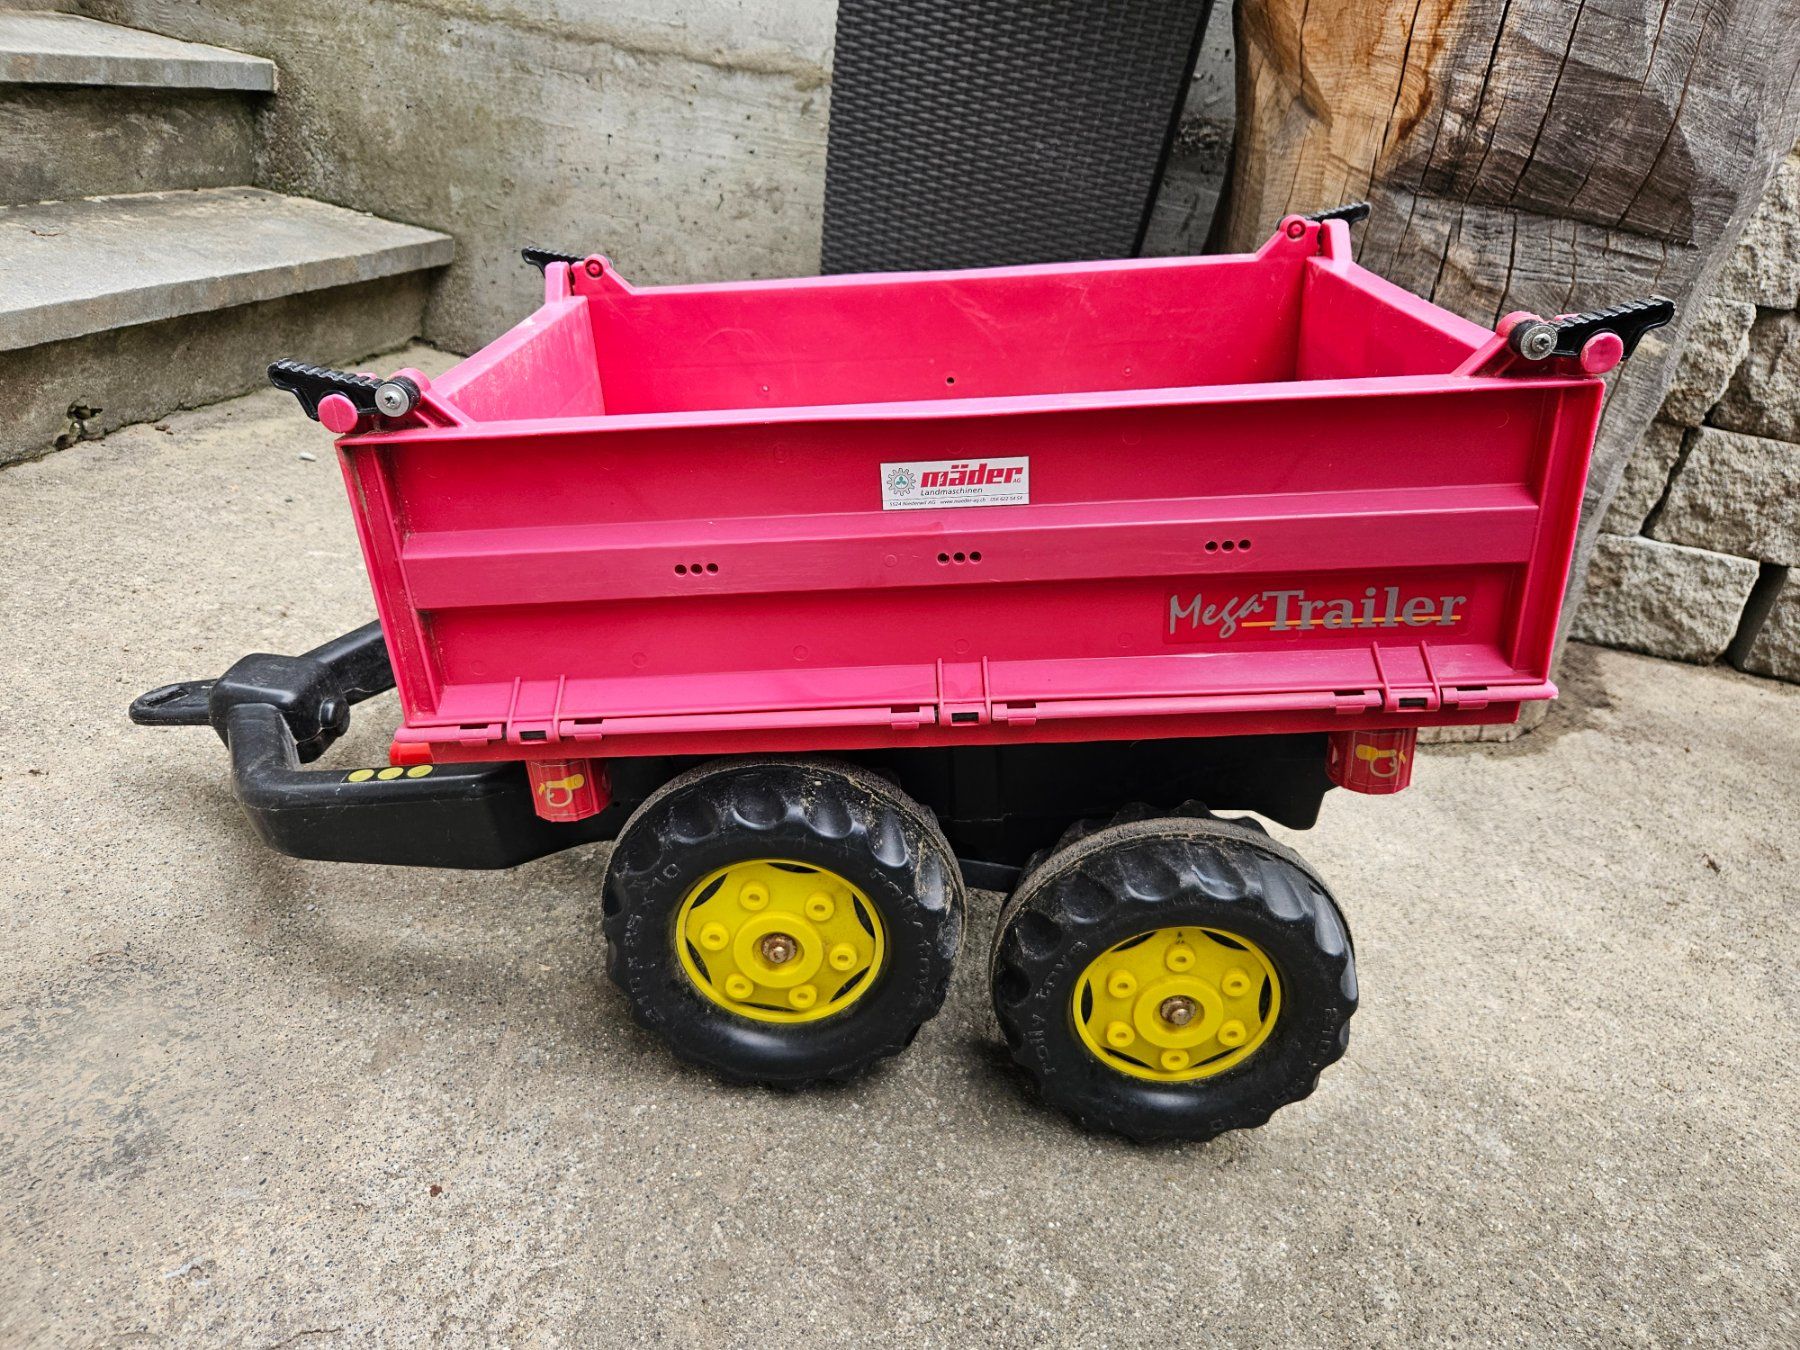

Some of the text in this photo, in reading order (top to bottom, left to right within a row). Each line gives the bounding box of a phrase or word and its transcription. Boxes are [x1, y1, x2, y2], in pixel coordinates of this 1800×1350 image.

[920, 463, 1024, 488] mäder
[920, 487, 983, 497] Landmaschinen
[1169, 586, 1467, 639] Mega Trailer
